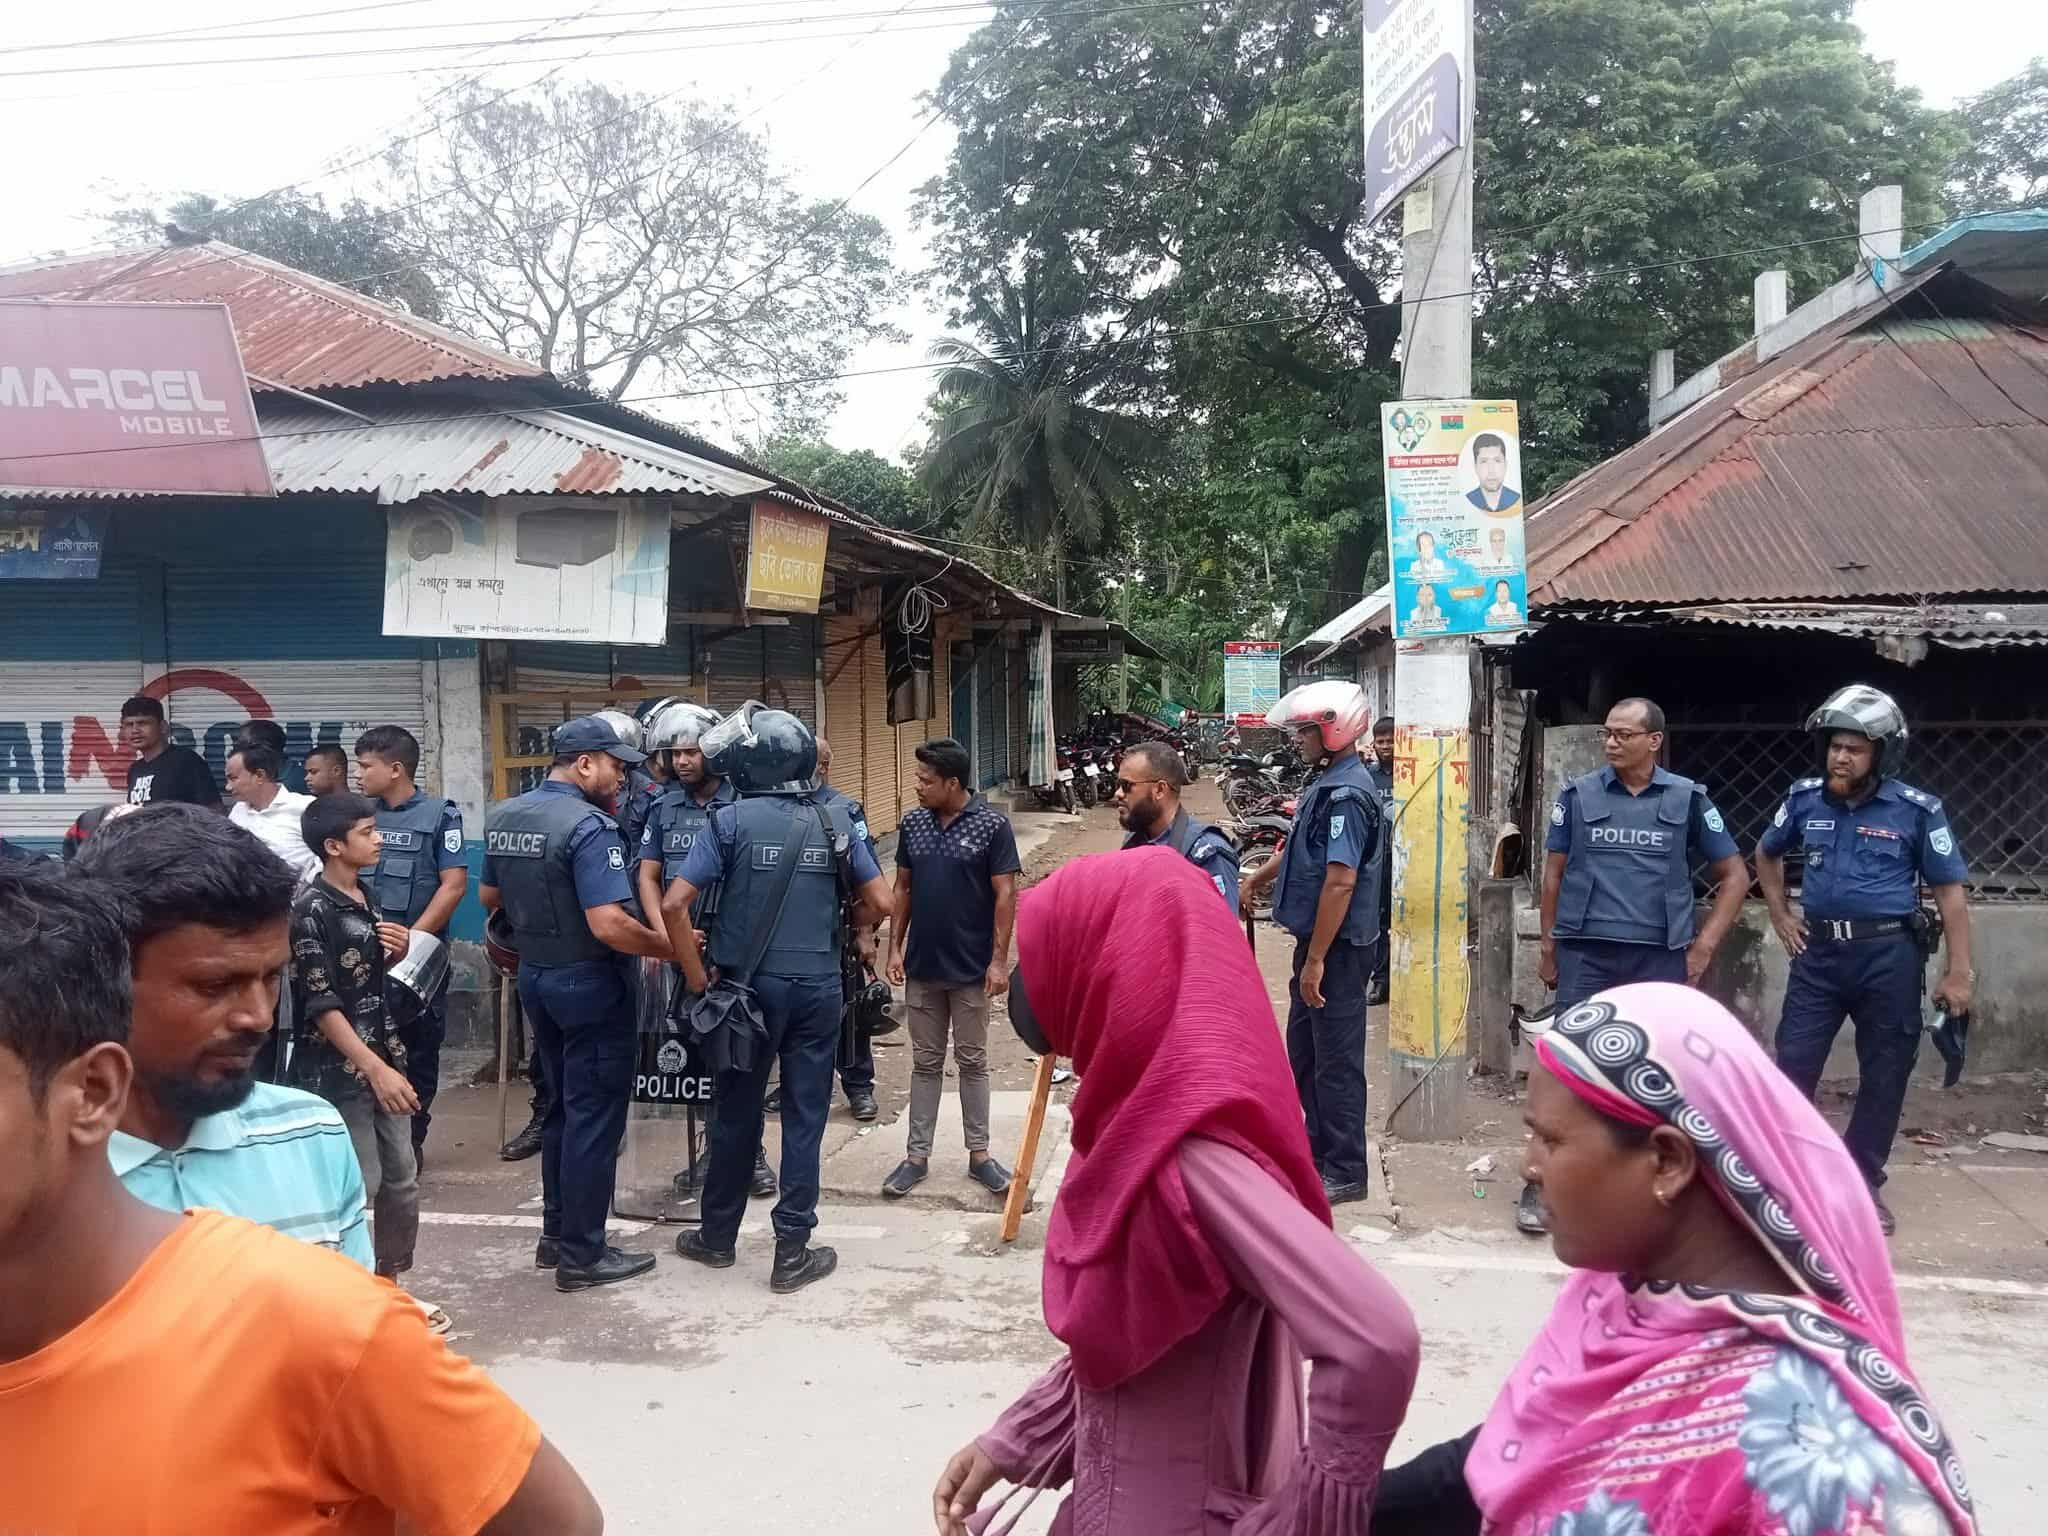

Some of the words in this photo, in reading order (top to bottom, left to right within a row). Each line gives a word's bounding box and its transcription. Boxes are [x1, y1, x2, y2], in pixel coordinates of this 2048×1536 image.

[0, 366, 226, 412] MARCEL
[120, 416, 233, 436] MOBILE
[488, 832, 544, 854] POLICE
[1590, 826, 1664, 848] POLICE
[769, 850, 822, 863] PCE
[635, 1075, 712, 1100] POLICE
